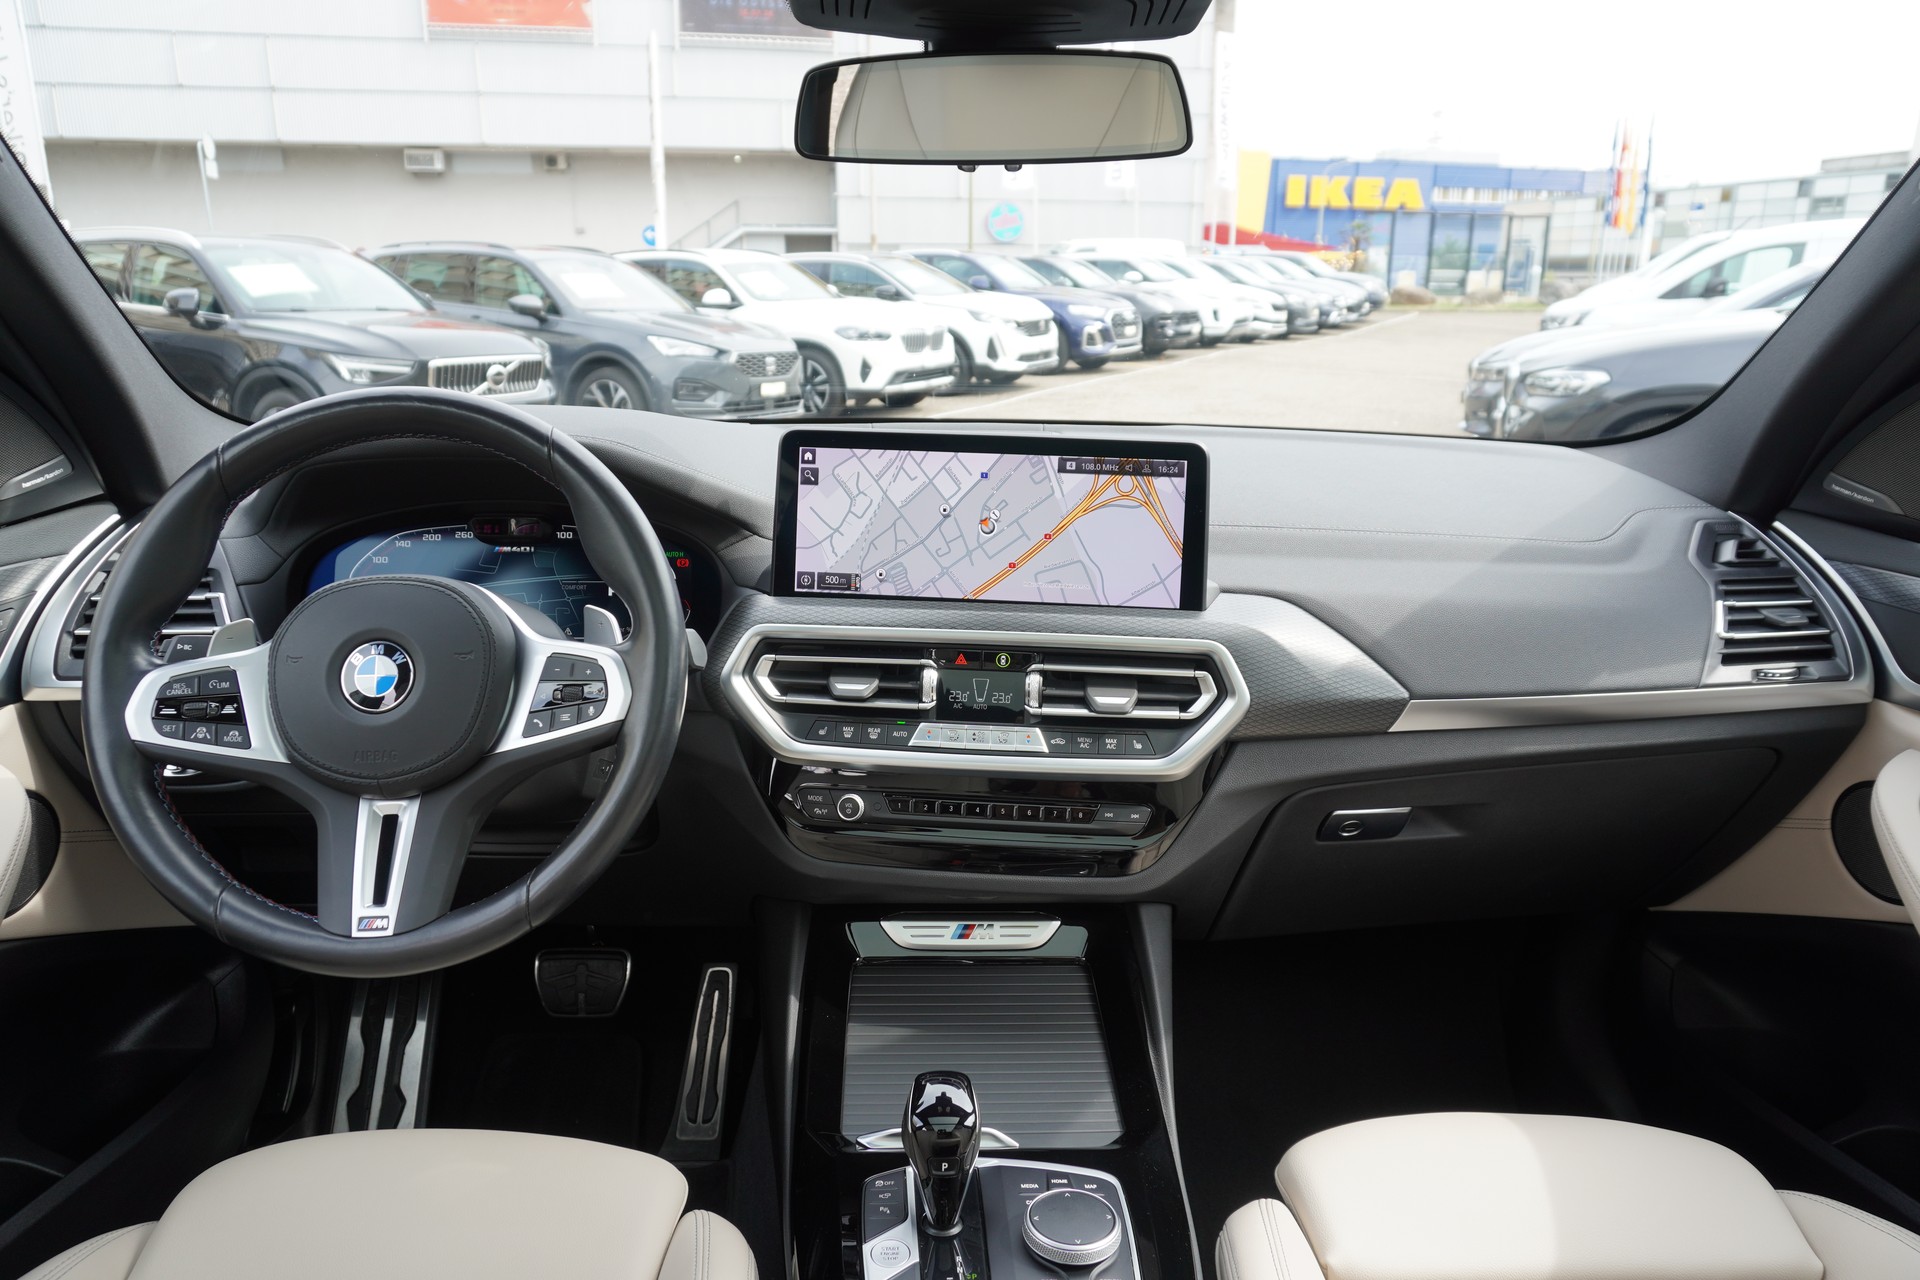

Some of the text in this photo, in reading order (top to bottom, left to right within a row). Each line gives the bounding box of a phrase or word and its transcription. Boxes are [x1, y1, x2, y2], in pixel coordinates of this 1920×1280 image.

[1285, 174, 1425, 210] IKEA
[22, 468, 64, 488] harman/kardon
[1832, 484, 1875, 503] harman/kardon
[455, 531, 474, 539] 260
[556, 531, 573, 539] 100
[395, 540, 411, 548] 140
[371, 556, 389, 564] 100
[825, 576, 839, 584] 500
[350, 645, 407, 666] BMW
[353, 750, 400, 763] AIRBAG
[807, 794, 824, 802] MODE
[941, 1162, 949, 1172] P
